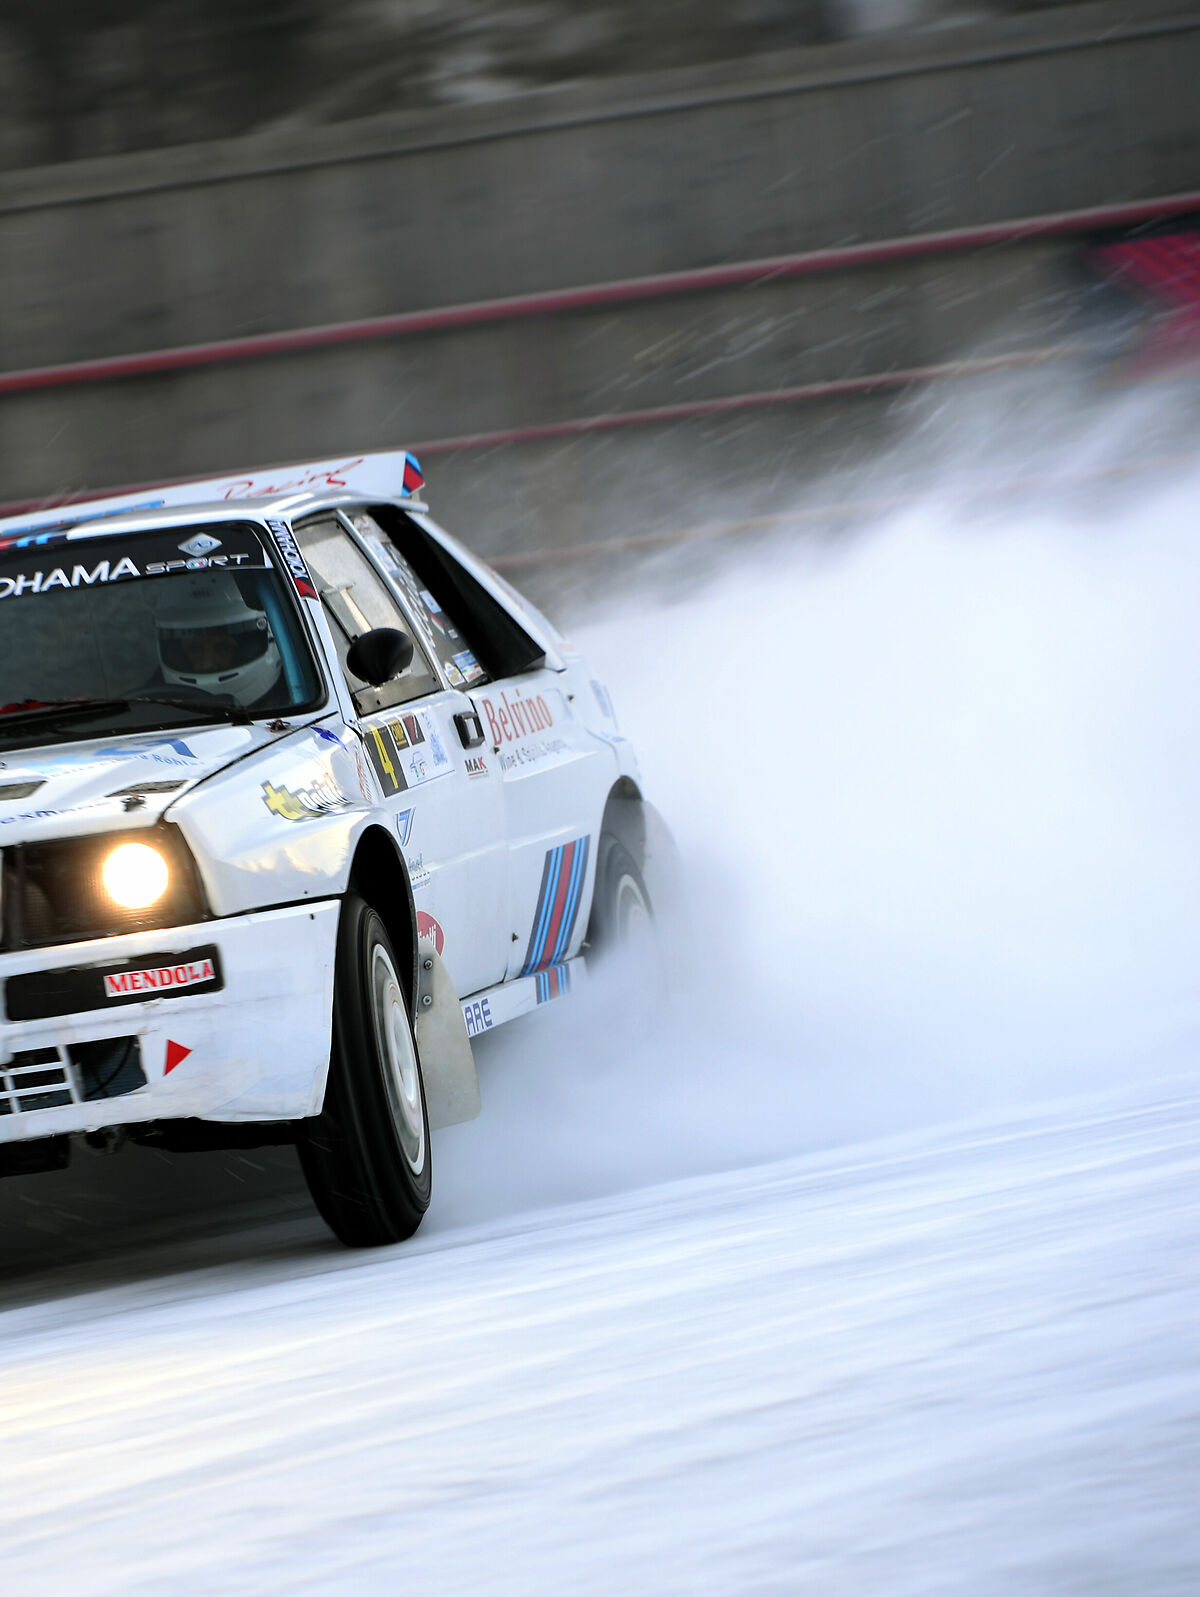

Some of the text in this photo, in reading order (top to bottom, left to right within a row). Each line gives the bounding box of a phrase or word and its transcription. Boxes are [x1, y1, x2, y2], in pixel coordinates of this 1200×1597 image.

[145, 553, 250, 575] SPORT
[482, 688, 554, 747] Belvino
[465, 756, 488, 773] MAK
[107, 961, 215, 994] MENDOLA
